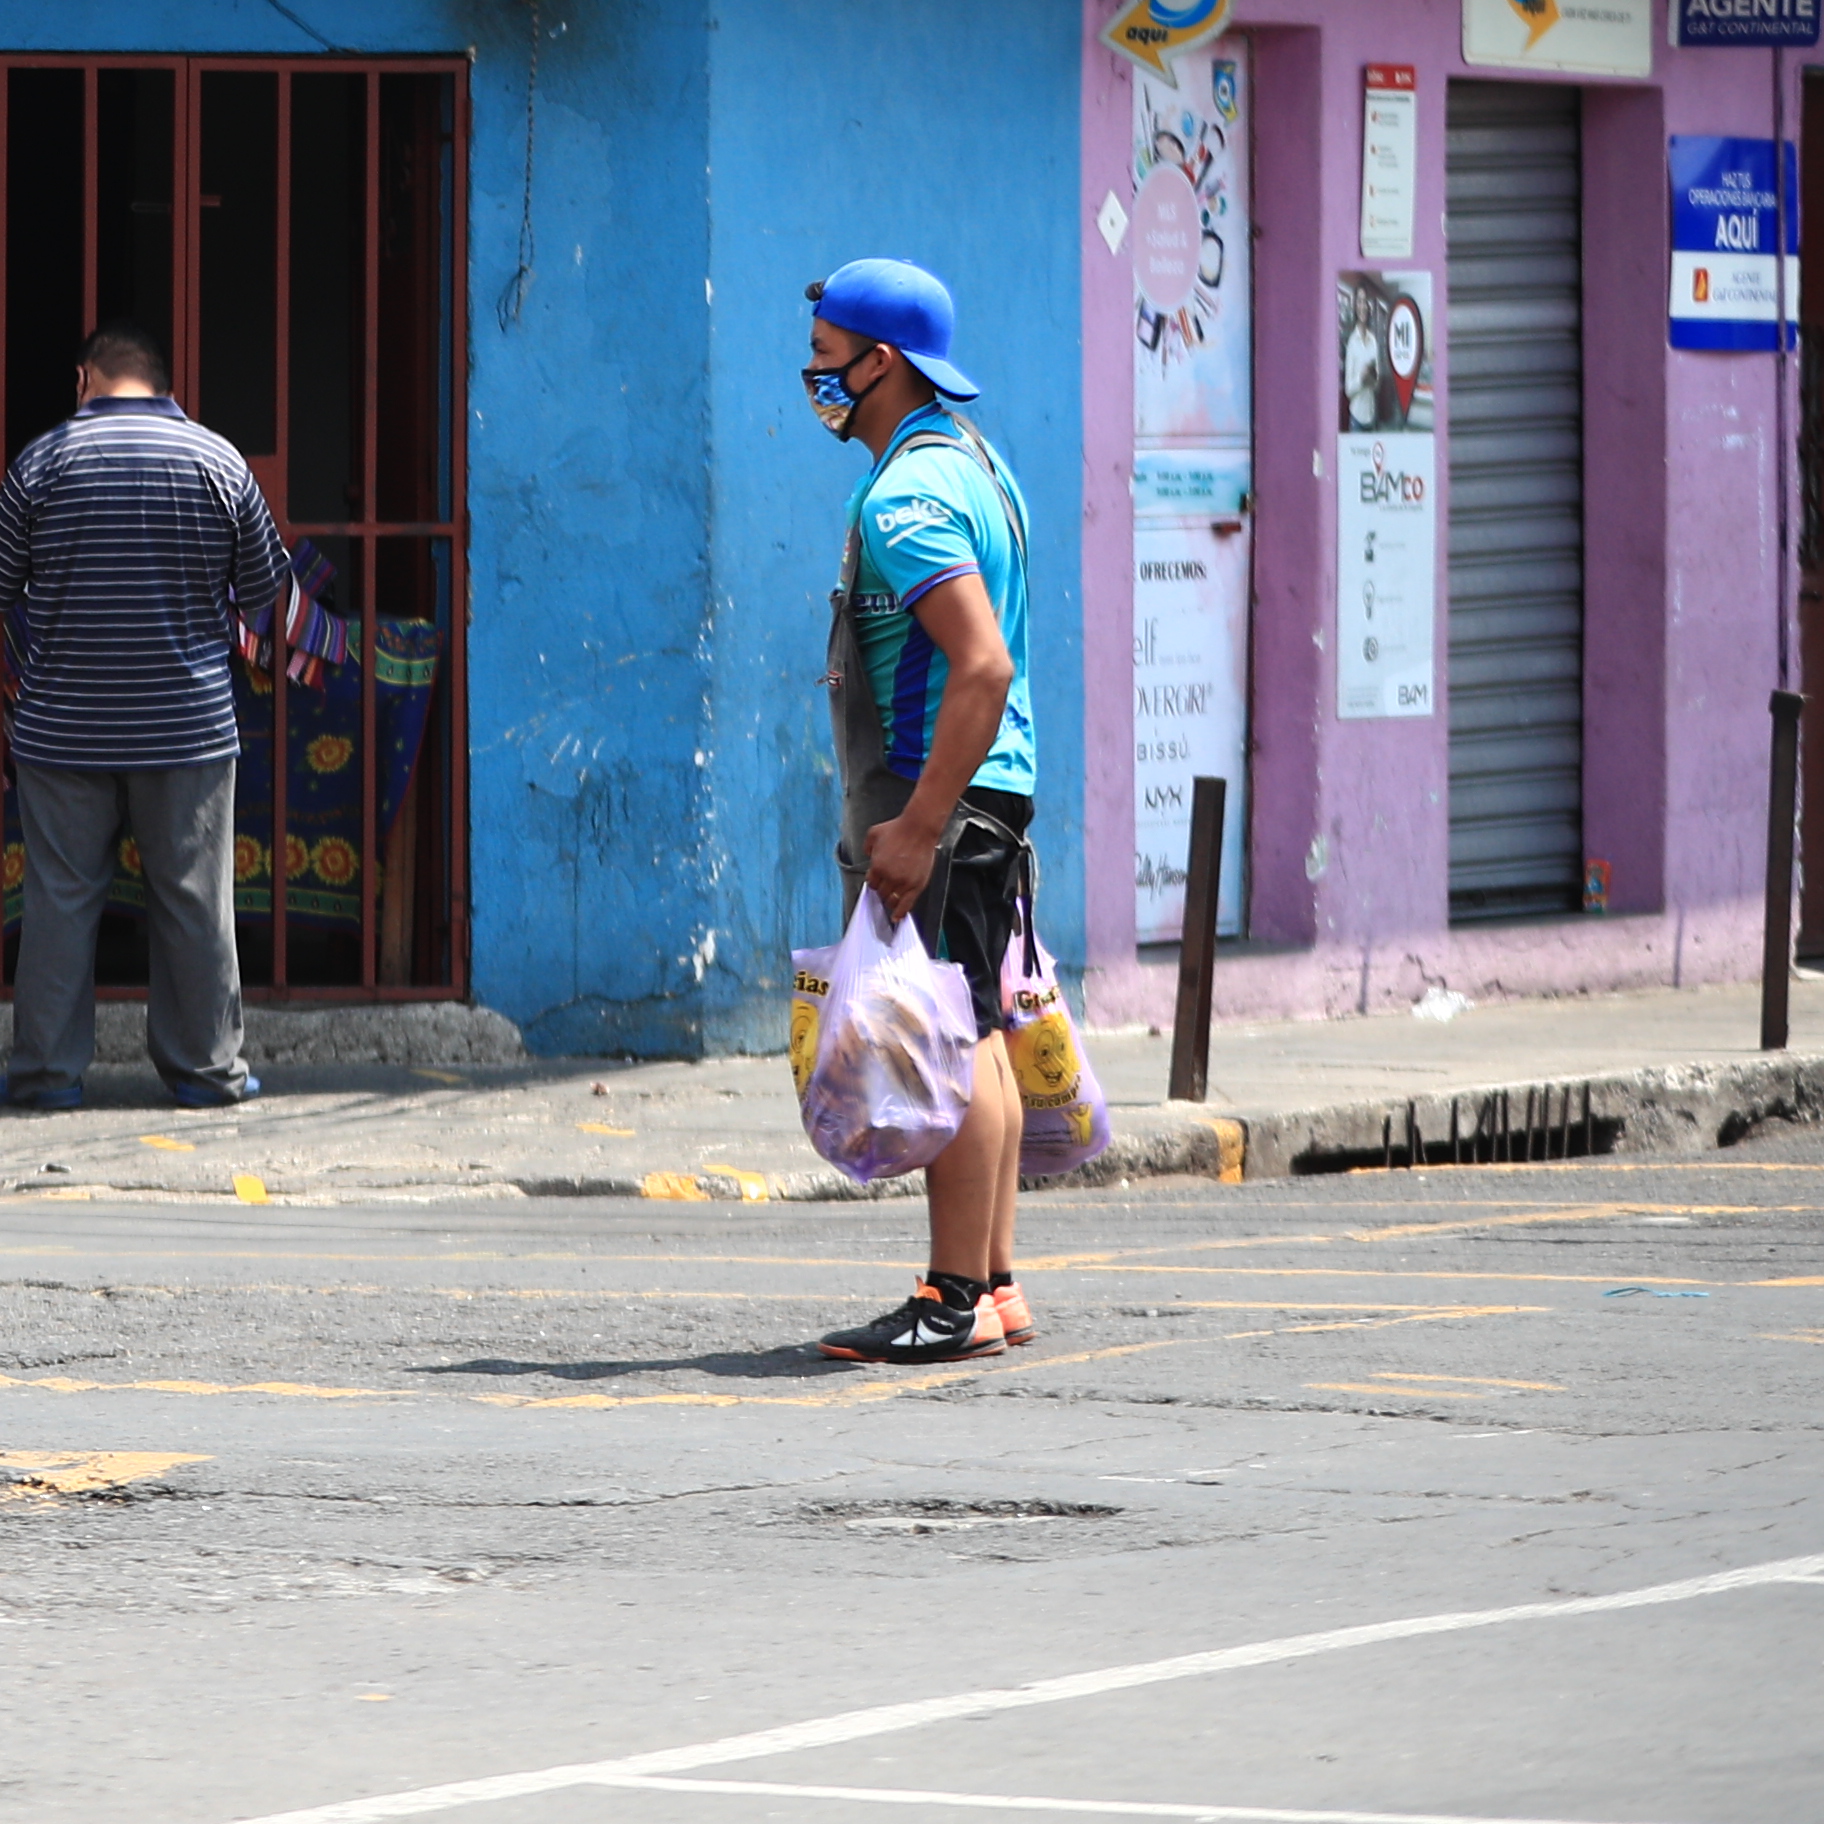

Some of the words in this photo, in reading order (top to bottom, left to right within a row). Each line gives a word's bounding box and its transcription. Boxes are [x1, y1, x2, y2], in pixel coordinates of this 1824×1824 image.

[1718, 21, 1814, 35] CONTINENTAL
[1741, 190, 1776, 208] BANCARIA
[1714, 208, 1759, 250] AQUÍ
